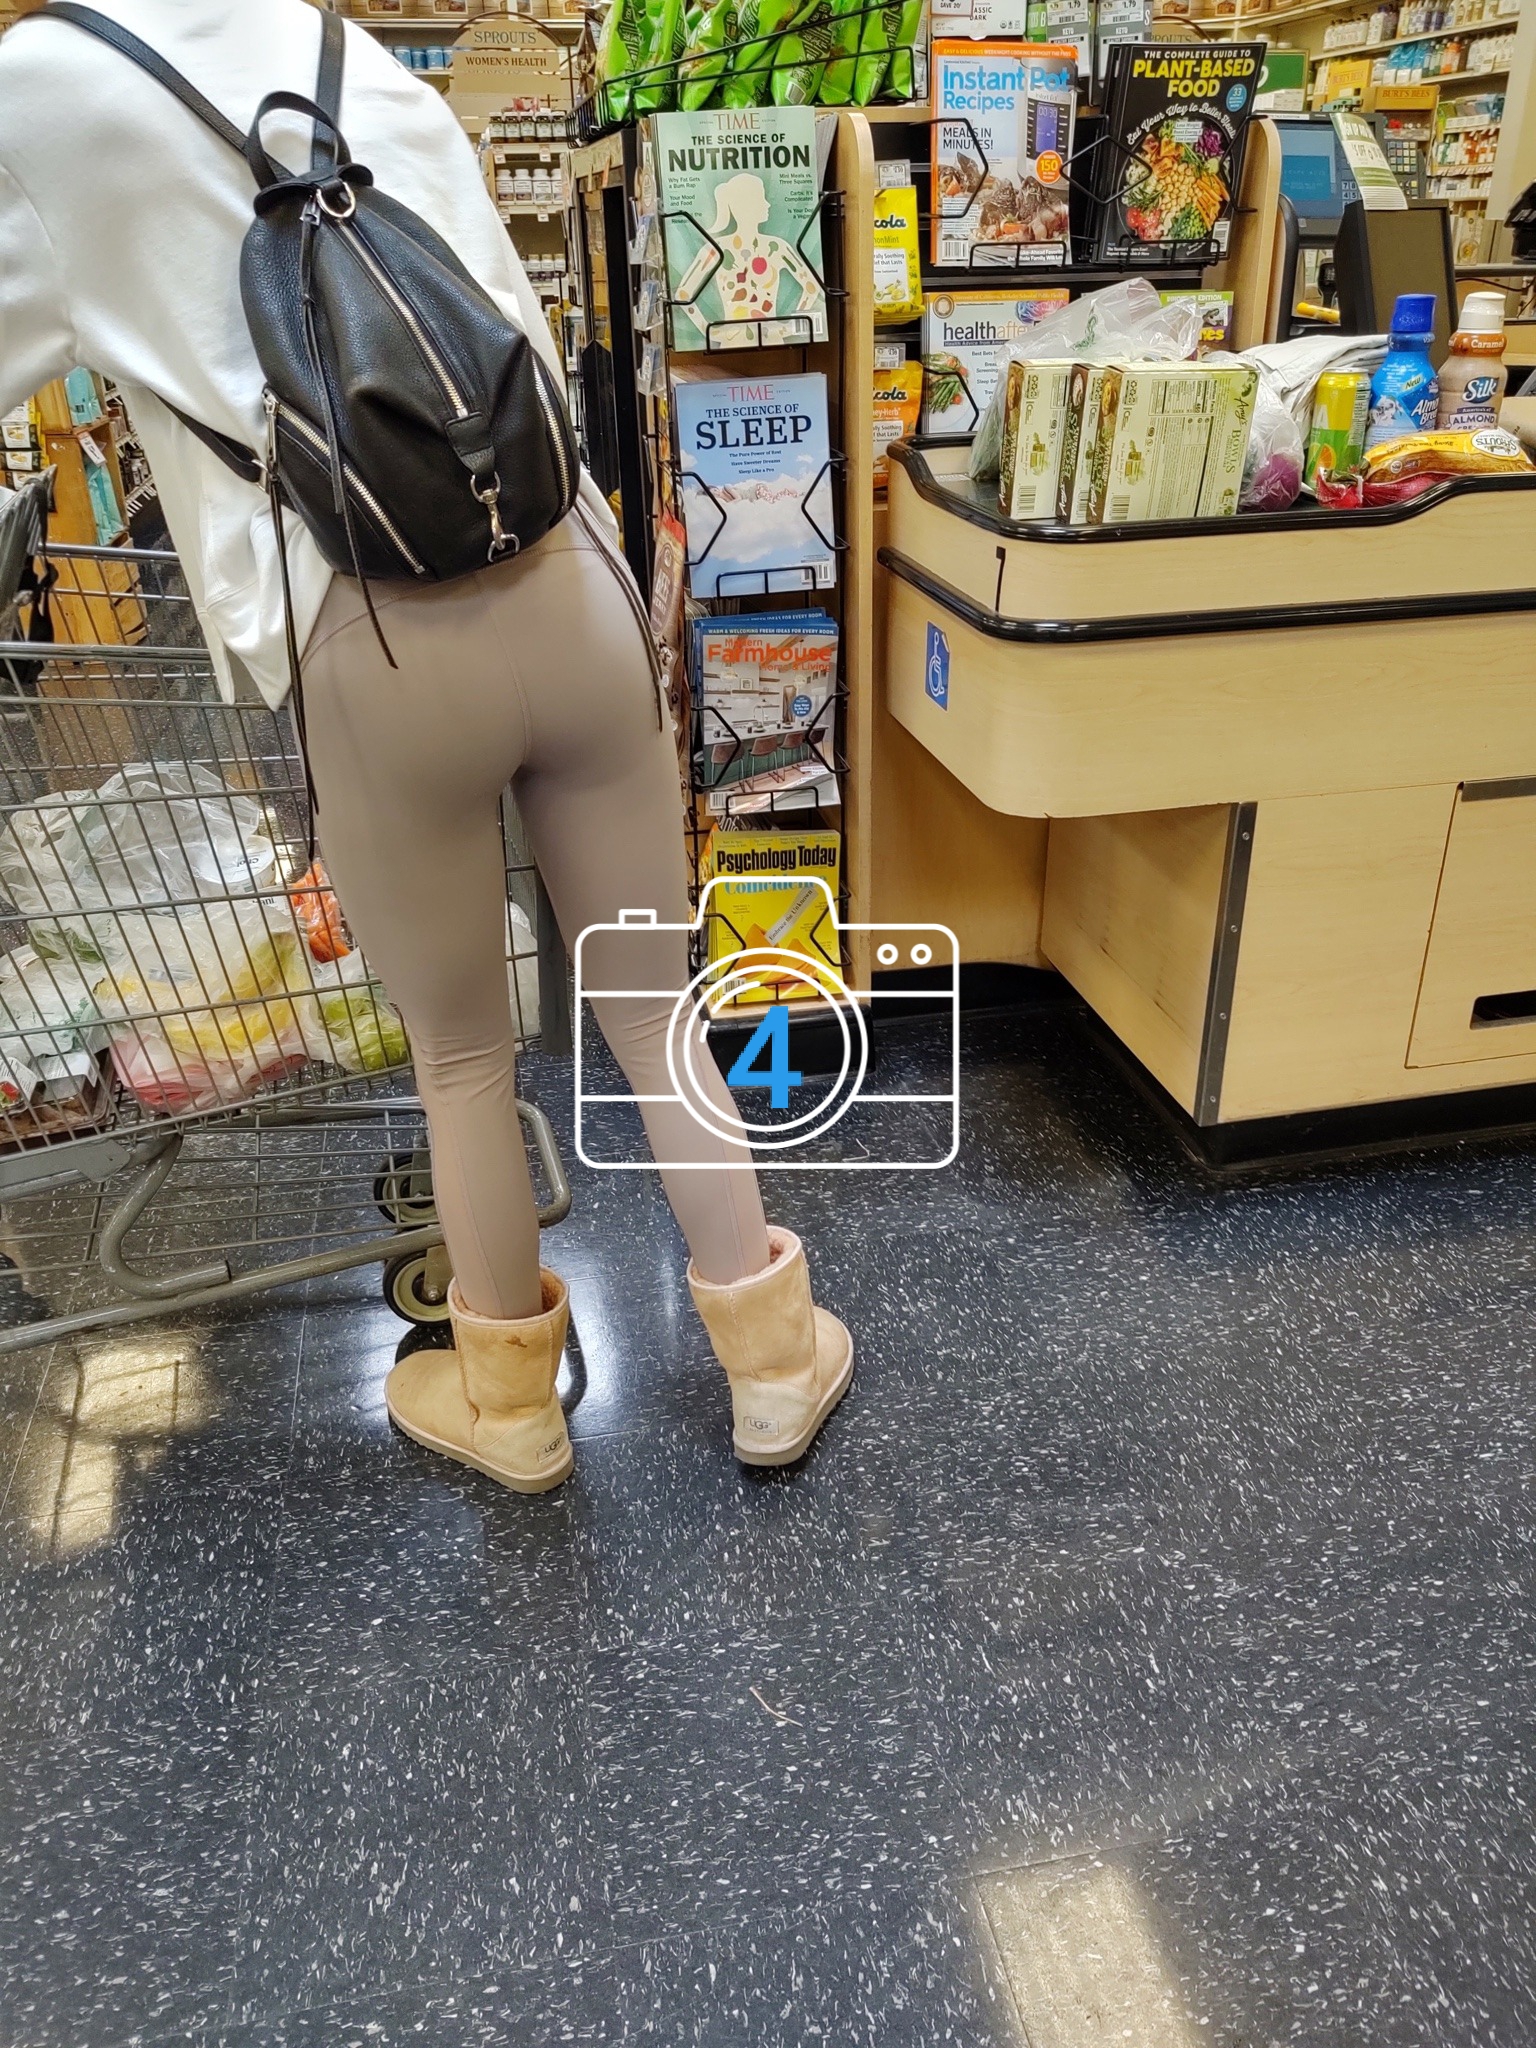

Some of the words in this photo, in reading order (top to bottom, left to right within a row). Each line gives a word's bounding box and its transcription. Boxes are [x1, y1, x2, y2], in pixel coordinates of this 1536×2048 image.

[474, 31, 537, 45] SPROUTS
[465, 56, 509, 67] WOMEN'S
[511, 58, 547, 67] HEALTH
[1144, 50, 1162, 59] THE
[1163, 50, 1211, 59] COMPLETE
[1212, 49, 1238, 59] GUIDE
[1240, 49, 1251, 57] TO
[1132, 58, 1256, 79] PLANT-BASED
[1332, 72, 1350, 83] BURT'S
[1350, 70, 1364, 81] BEES
[943, 64, 1025, 91] Instant
[1030, 66, 1070, 92] Pot
[1166, 79, 1221, 98] FOOD
[1382, 89, 1410, 98] BURT'S
[1411, 89, 1431, 98] BEES
[943, 90, 1015, 115] Recipes
[713, 112, 760, 130] TIME
[1126, 128, 1142, 146] Eat
[1141, 112, 1166, 133] Your
[1165, 103, 1188, 117] Way
[1187, 102, 1199, 113] to
[1199, 102, 1222, 120] Better
[691, 135, 713, 146] THE
[717, 134, 767, 145] SCIENCE
[771, 133, 786, 143] OF
[943, 127, 979, 138] MEALS
[980, 127, 992, 138] IN
[943, 139, 993, 150] MINUTES!
[668, 144, 811, 172] NUTRITION
[1040, 160, 1058, 171] 150
[793, 178, 813, 186] Squares
[784, 195, 814, 203] Complicated
[873, 214, 907, 229] cola
[884, 252, 905, 261] Soothing
[1470, 338, 1504, 349] Caramel
[1405, 377, 1421, 390] New
[1462, 378, 1497, 402] Silk
[727, 384, 775, 402] TIME
[706, 408, 730, 419] THE
[732, 404, 782, 418] SCIENCE
[784, 403, 800, 414] OF
[1233, 396, 1250, 426] Amy's
[1410, 399, 1439, 417] Almo
[881, 424, 902, 432] Soothing
[1452, 414, 1495, 425] ALMOND
[695, 414, 812, 450] SLEEP
[1064, 413, 1079, 481] BOWLS
[1225, 429, 1242, 474] BOWLS
[1475, 437, 1517, 451] SPROUTS
[998, 472, 1008, 508] Amy's
[1058, 482, 1068, 517] Amy's
[1088, 482, 1098, 517] Amy's
[654, 568, 671, 604] BEEF
[707, 642, 832, 663] Farmhouse
[801, 662, 831, 673] Living
[716, 847, 797, 874] Psychology
[797, 844, 837, 867] Today
[768, 920, 787, 941] Embrace
[785, 913, 794, 923] the
[791, 889, 813, 915] Unknown
